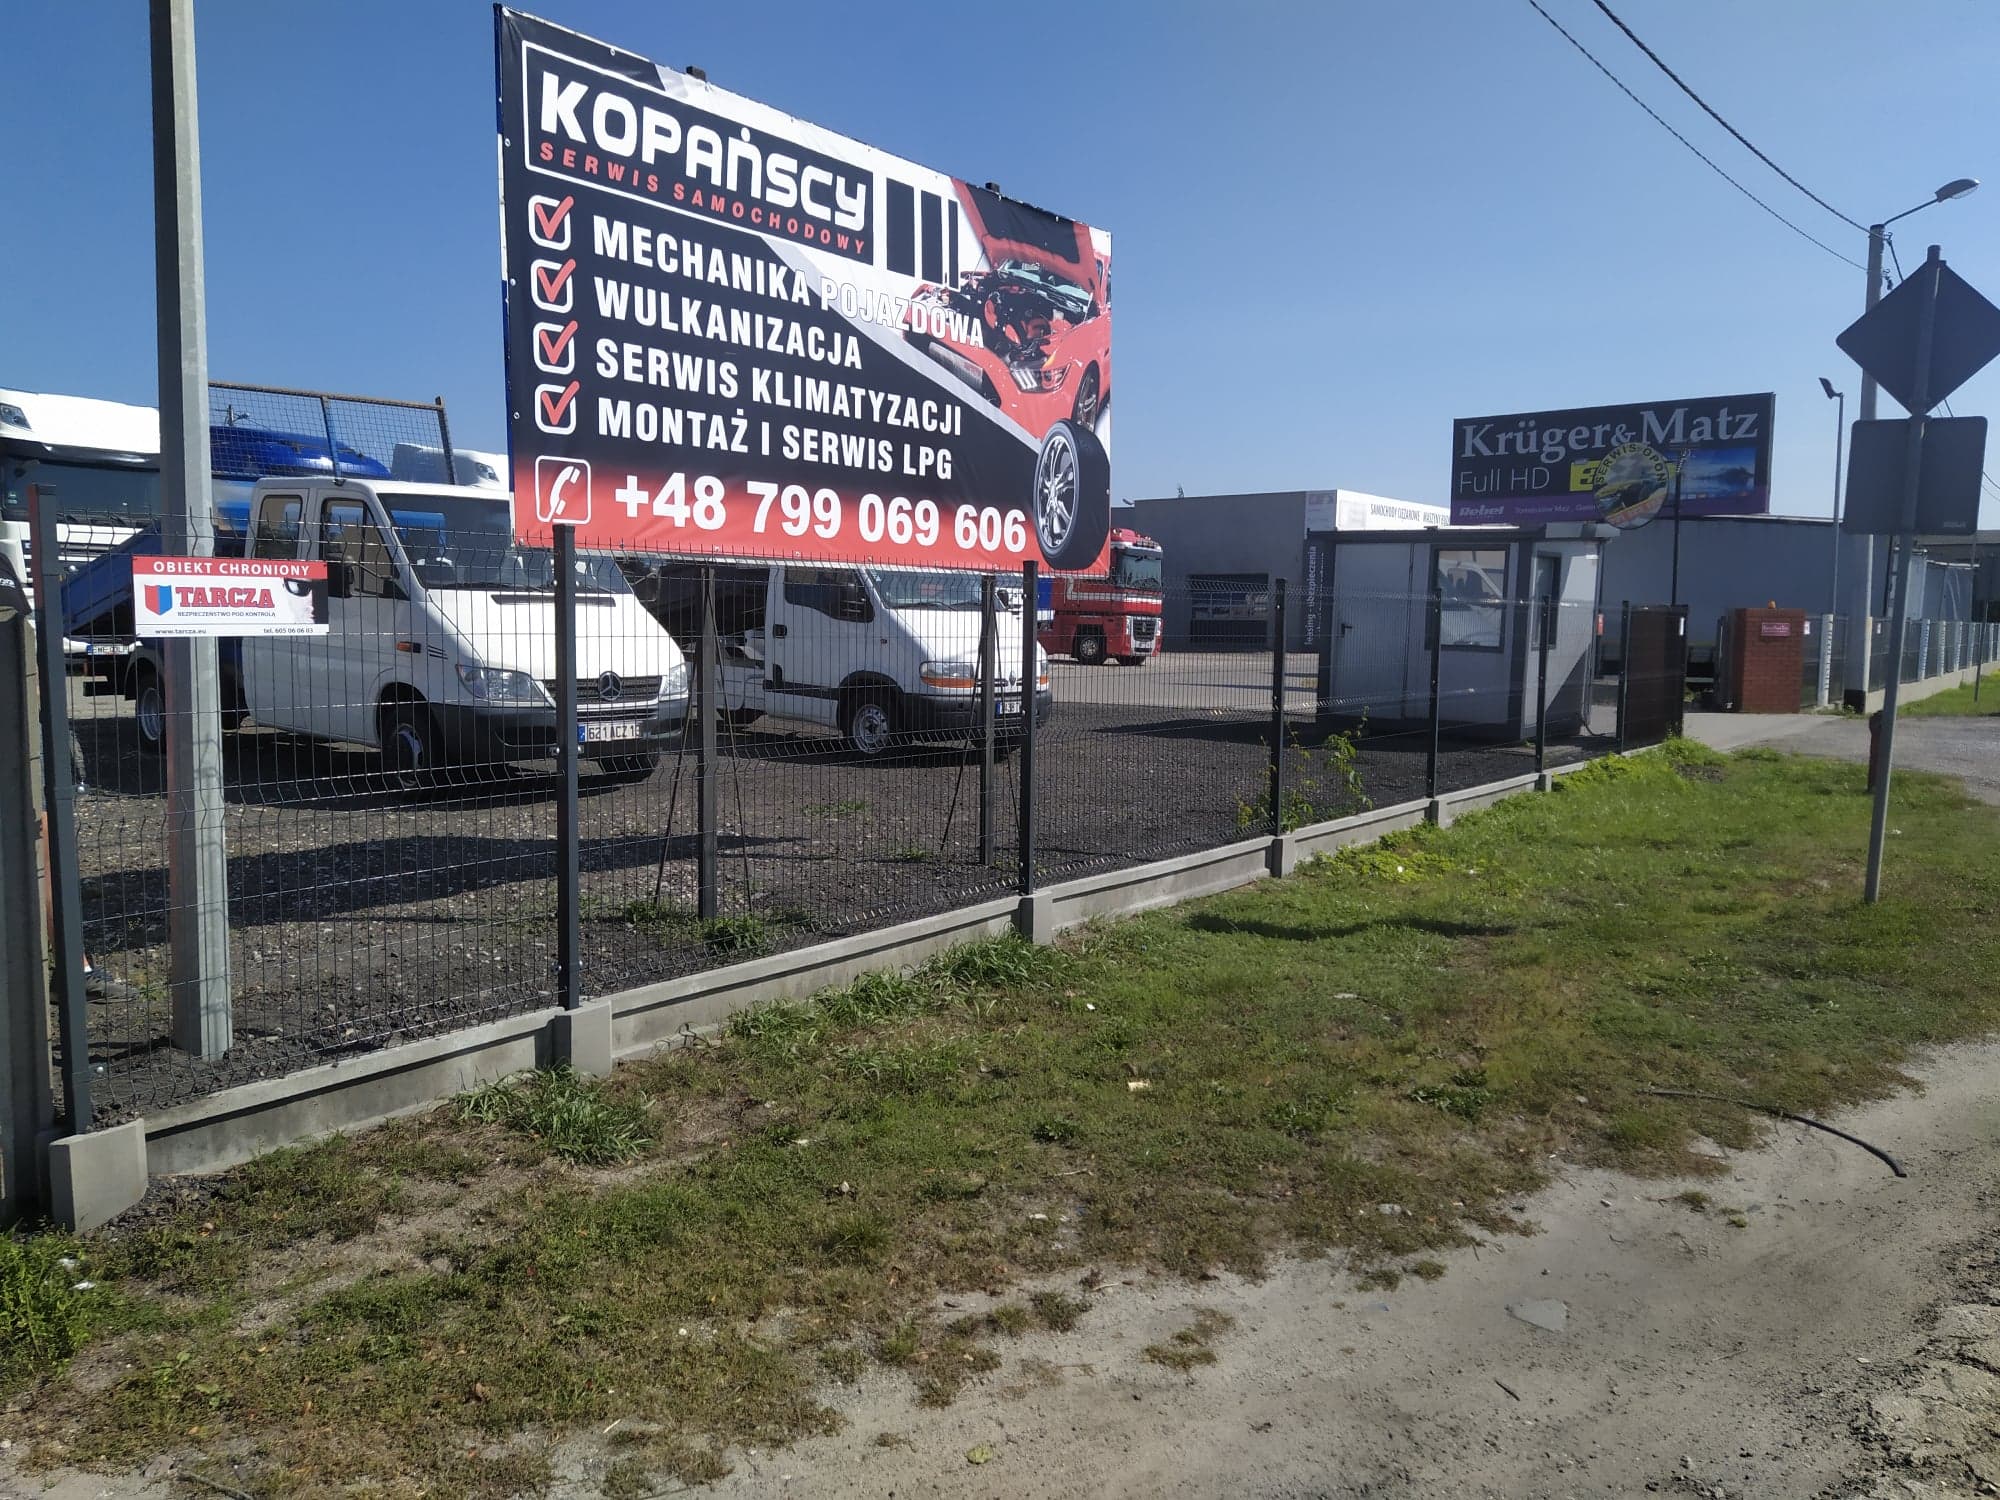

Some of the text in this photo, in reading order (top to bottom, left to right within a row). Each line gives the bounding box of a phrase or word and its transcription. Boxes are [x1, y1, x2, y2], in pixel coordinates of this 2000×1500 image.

[540, 142, 866, 255] SERWIS SAMOCHODOWY
[593, 215, 985, 349] MECHANIKA POJAZDOWA
[596, 276, 862, 369] WULKANIZACJA
[597, 337, 962, 436] SERWIS KLIMATYZACJI
[598, 397, 953, 480] MONTAŻ I SERWIS LPG
[1596, 443, 1638, 483] SERWIS
[615, 472, 1027, 553] +48 799 069 606
[1459, 469, 1501, 494] Full
[1511, 467, 1550, 490] HD
[153, 561, 310, 576] OBIEKT CHRONIONY
[175, 586, 276, 609] TARCZA
